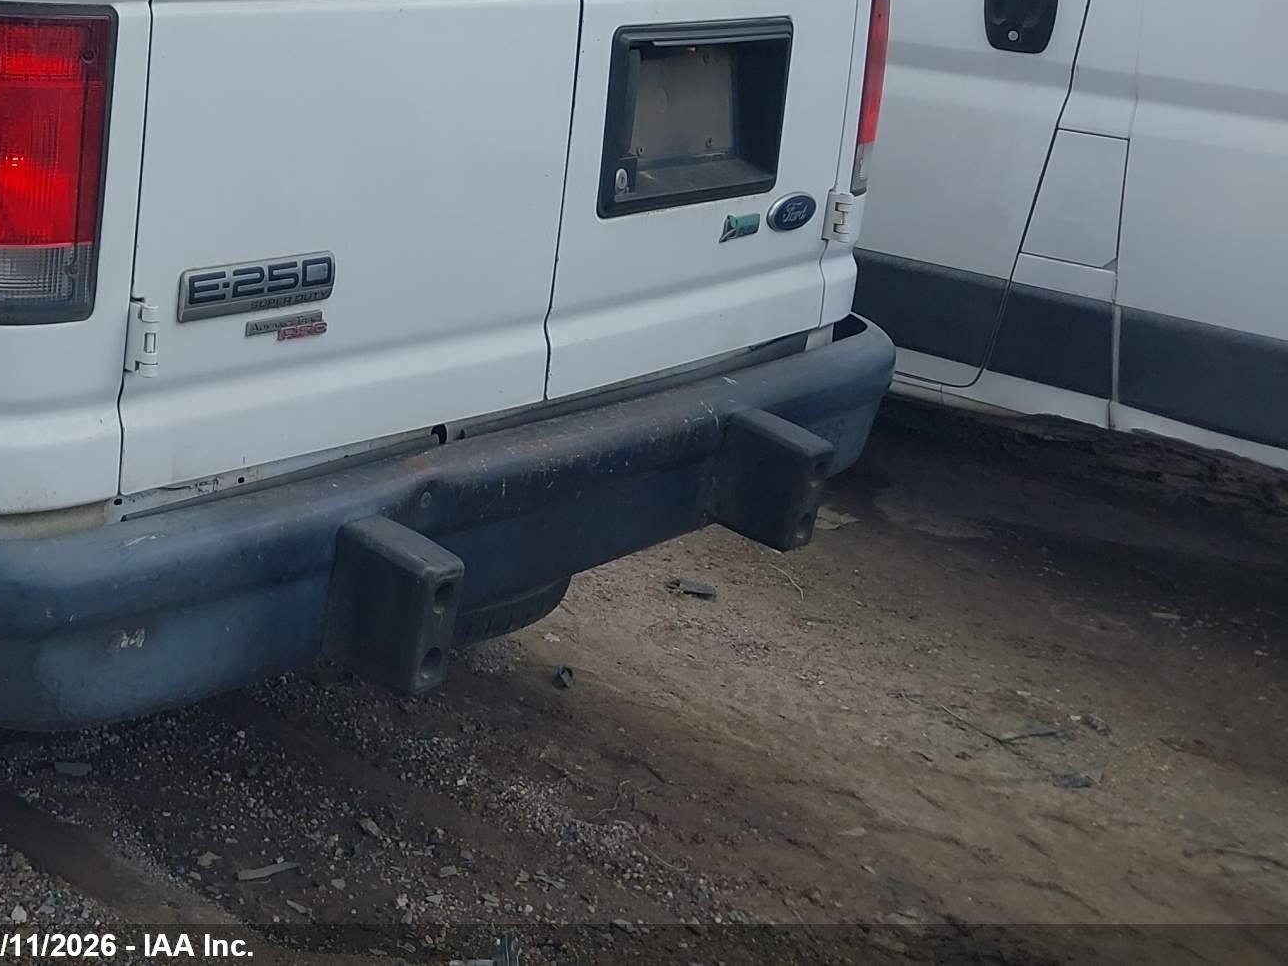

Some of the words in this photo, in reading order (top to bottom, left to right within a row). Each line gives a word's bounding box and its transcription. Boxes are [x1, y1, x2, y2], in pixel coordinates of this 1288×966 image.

[782, 201, 809, 223] Ford
[187, 255, 332, 305] E-250
[250, 295, 292, 309] SUPER
[294, 288, 329, 302] DUTY
